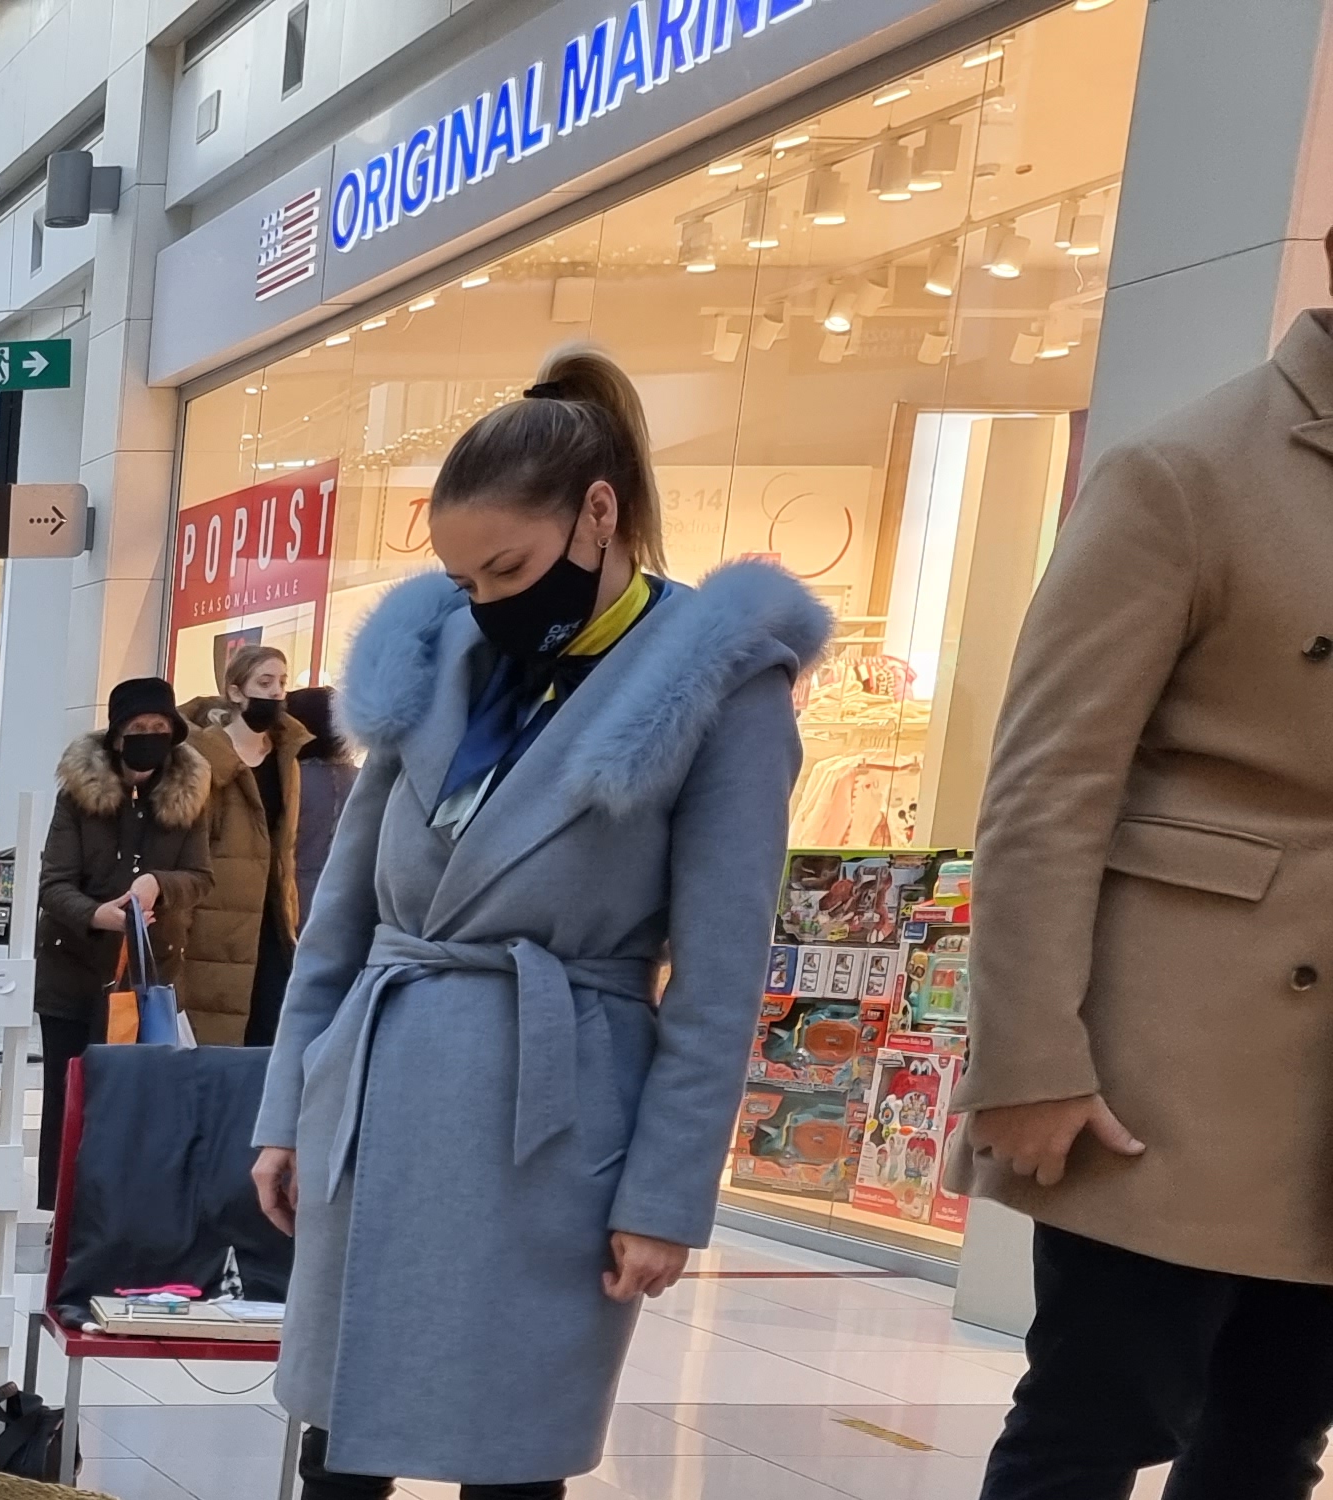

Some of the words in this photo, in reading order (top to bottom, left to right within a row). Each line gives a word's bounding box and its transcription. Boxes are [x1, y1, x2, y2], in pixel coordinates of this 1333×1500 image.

[332, 61, 550, 252] ORIGINAL
[180, 478, 335, 591] POPUST
[193, 591, 256, 617] SEASONAL
[266, 578, 299, 600] SALE
